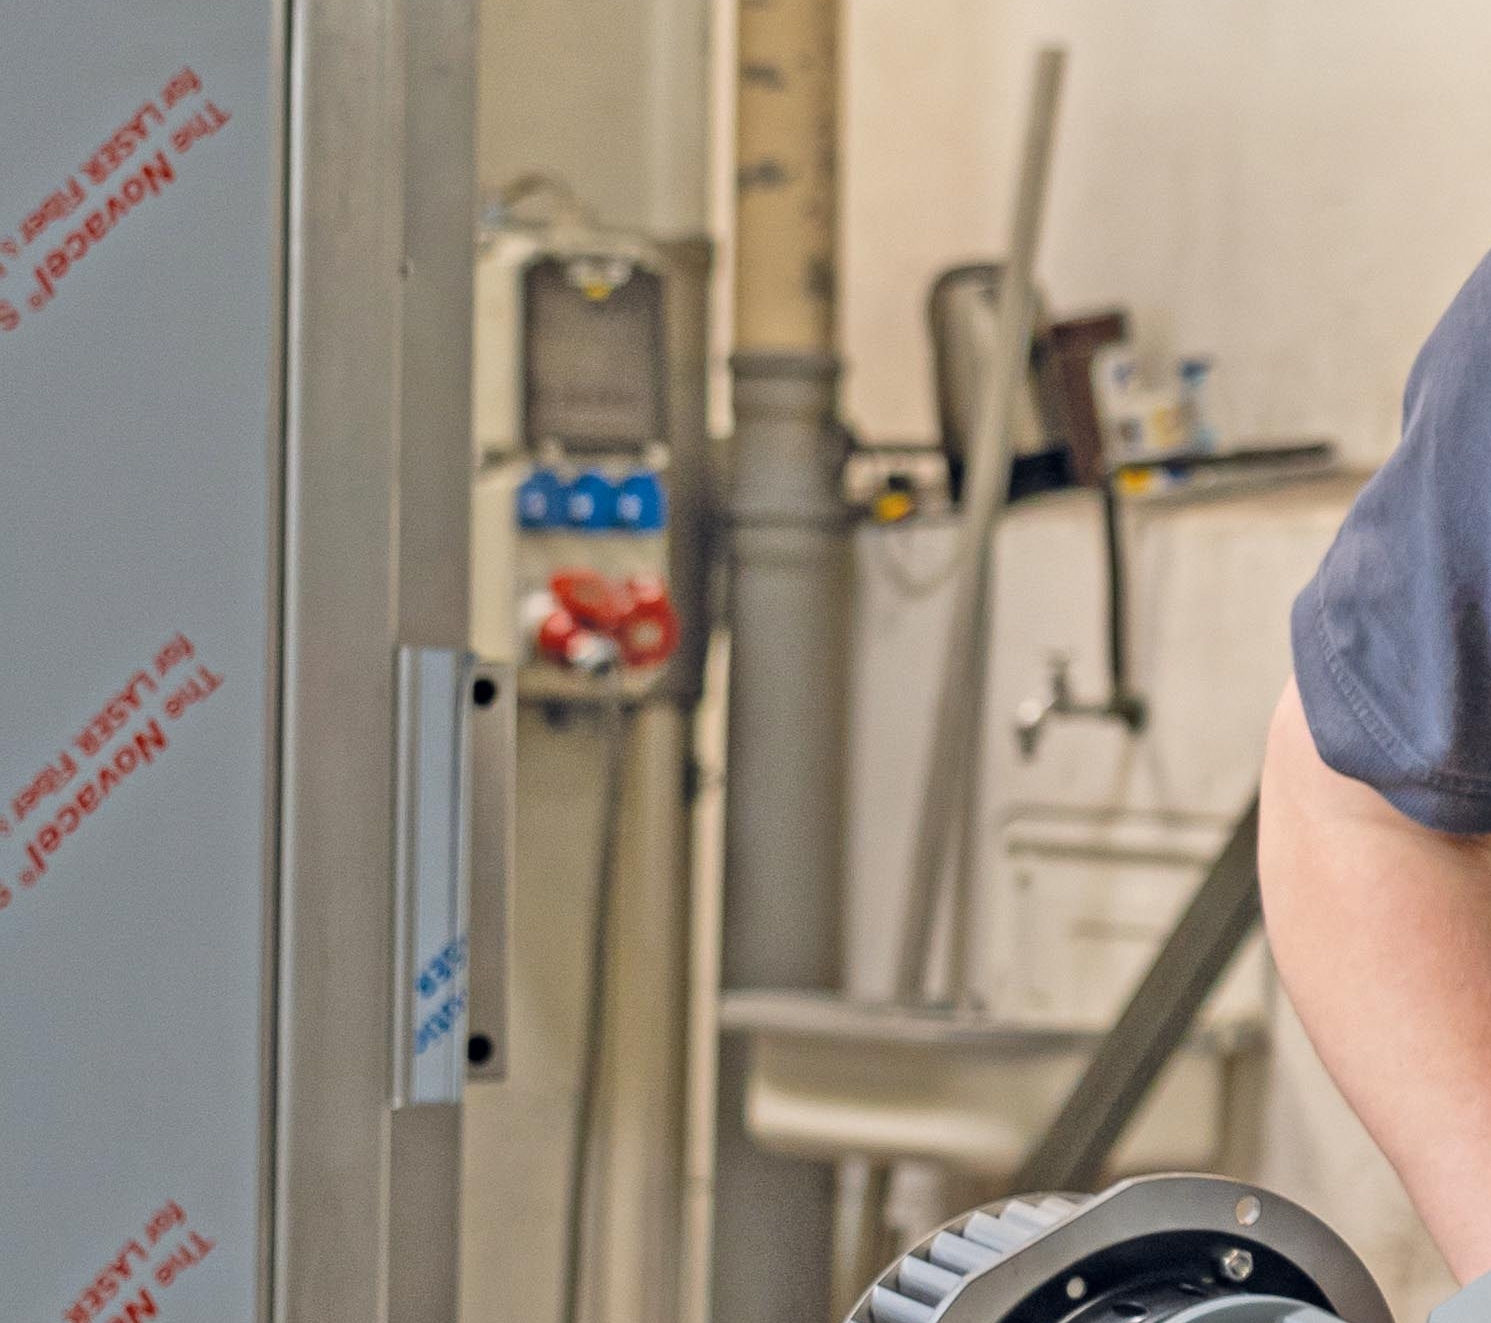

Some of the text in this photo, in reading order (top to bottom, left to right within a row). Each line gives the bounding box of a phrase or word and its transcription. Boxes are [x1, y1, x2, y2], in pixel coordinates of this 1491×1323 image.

[170, 102, 230, 153] The
[163, 666, 222, 719] The
[154, 1232, 214, 1287] The
